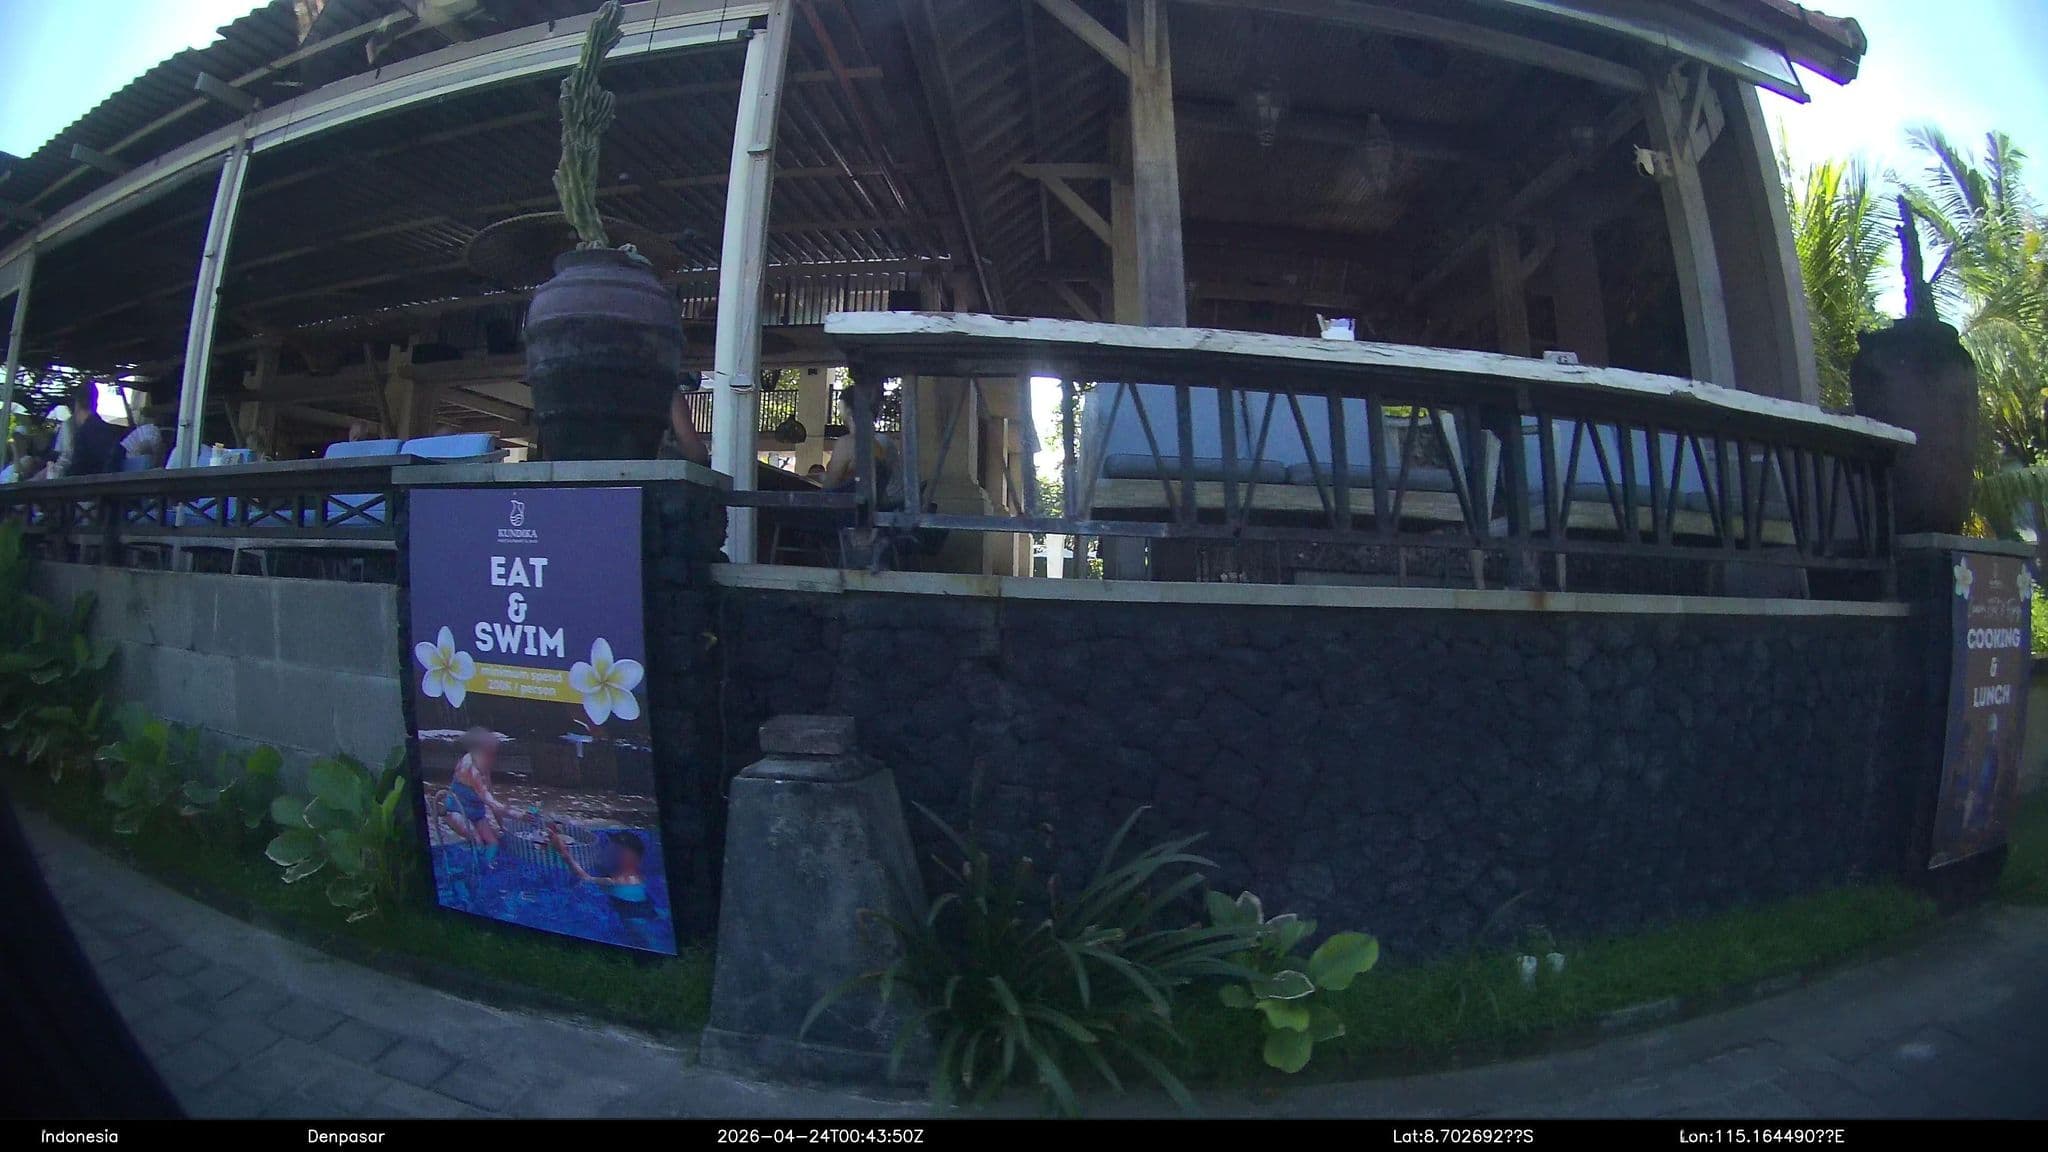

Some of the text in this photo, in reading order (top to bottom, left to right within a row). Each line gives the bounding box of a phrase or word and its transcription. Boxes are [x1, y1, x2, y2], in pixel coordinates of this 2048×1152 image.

[497, 528, 538, 538] KUNDIKA
[490, 556, 548, 588] EAT
[507, 592, 528, 623] &
[474, 621, 565, 658] SWIM
[1966, 627, 2021, 649] COOKING
[1989, 656, 2000, 678] &
[531, 672, 562, 686] spend
[520, 684, 557, 698] person
[1972, 683, 2011, 708] LUNCH
